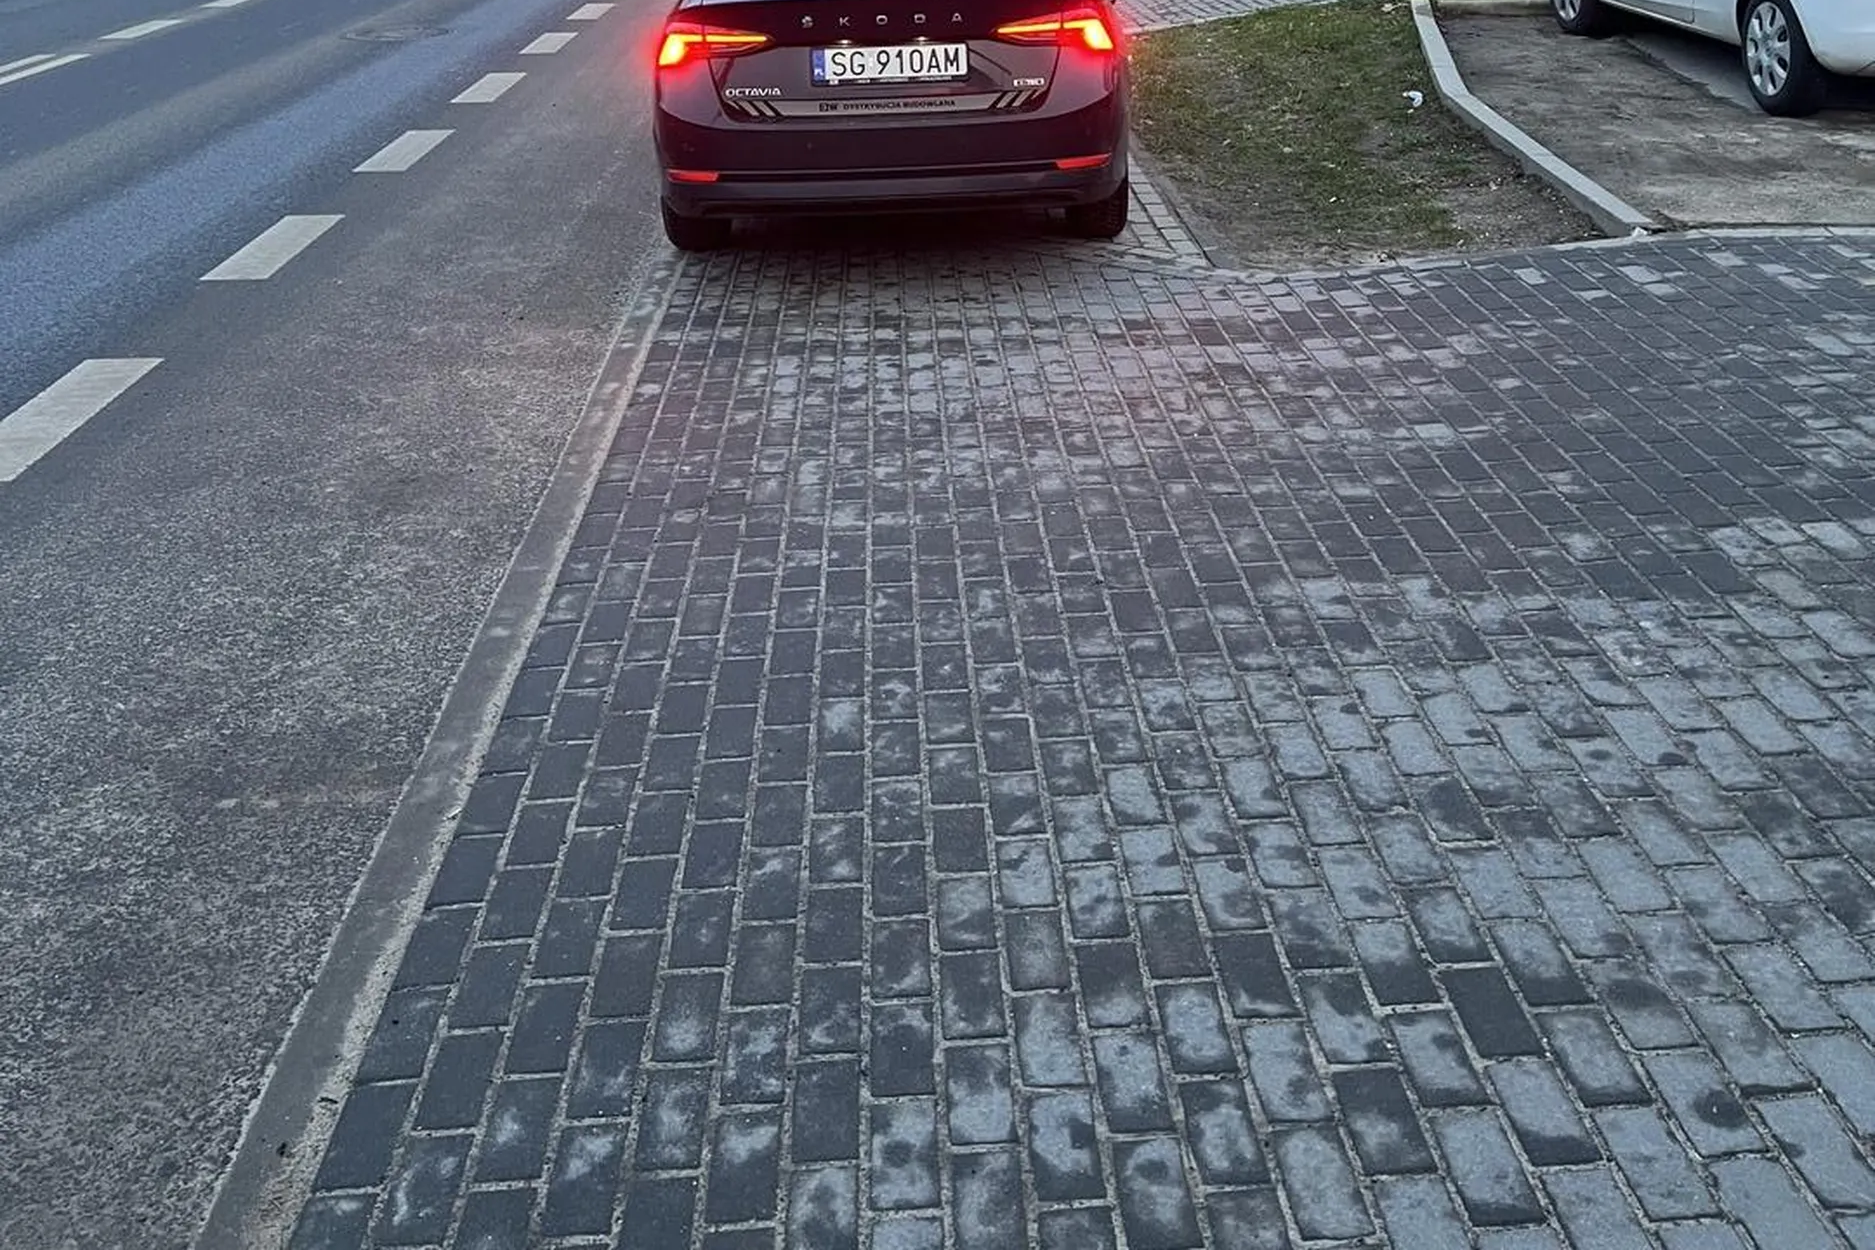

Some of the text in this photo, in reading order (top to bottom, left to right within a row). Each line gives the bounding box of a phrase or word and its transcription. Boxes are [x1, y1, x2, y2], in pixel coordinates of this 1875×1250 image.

[831, 47, 960, 77] SG 910AM
[725, 87, 781, 98] OCTAVIA
